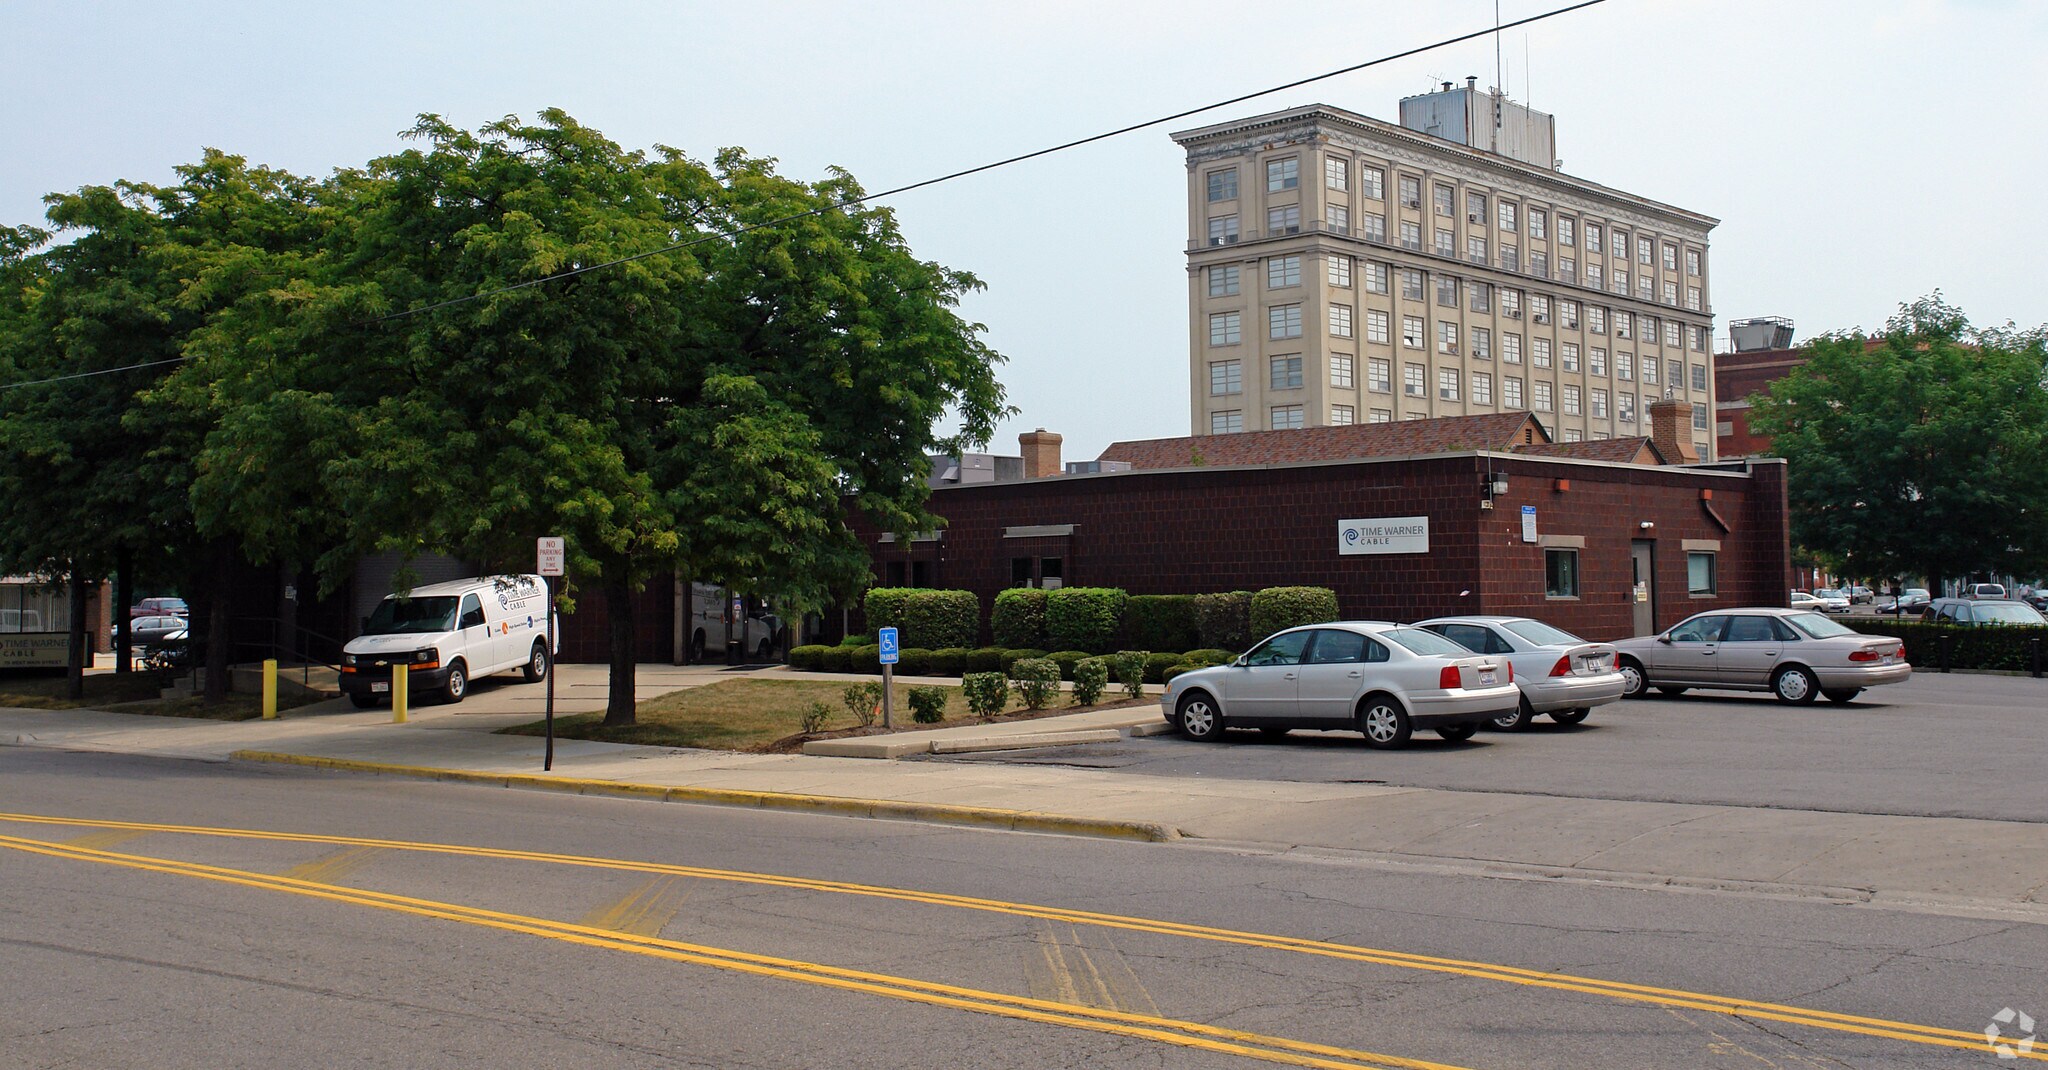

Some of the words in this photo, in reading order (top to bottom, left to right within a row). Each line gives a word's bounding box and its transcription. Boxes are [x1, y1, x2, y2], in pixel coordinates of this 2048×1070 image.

[1360, 527, 1382, 536] TIME
[1385, 525, 1424, 536] WARNER
[1360, 537, 1390, 545] CABLE
[506, 589, 520, 600] TIME
[520, 585, 541, 597] WARNER
[509, 600, 526, 610] CABLE
[5, 639, 29, 648] TIME
